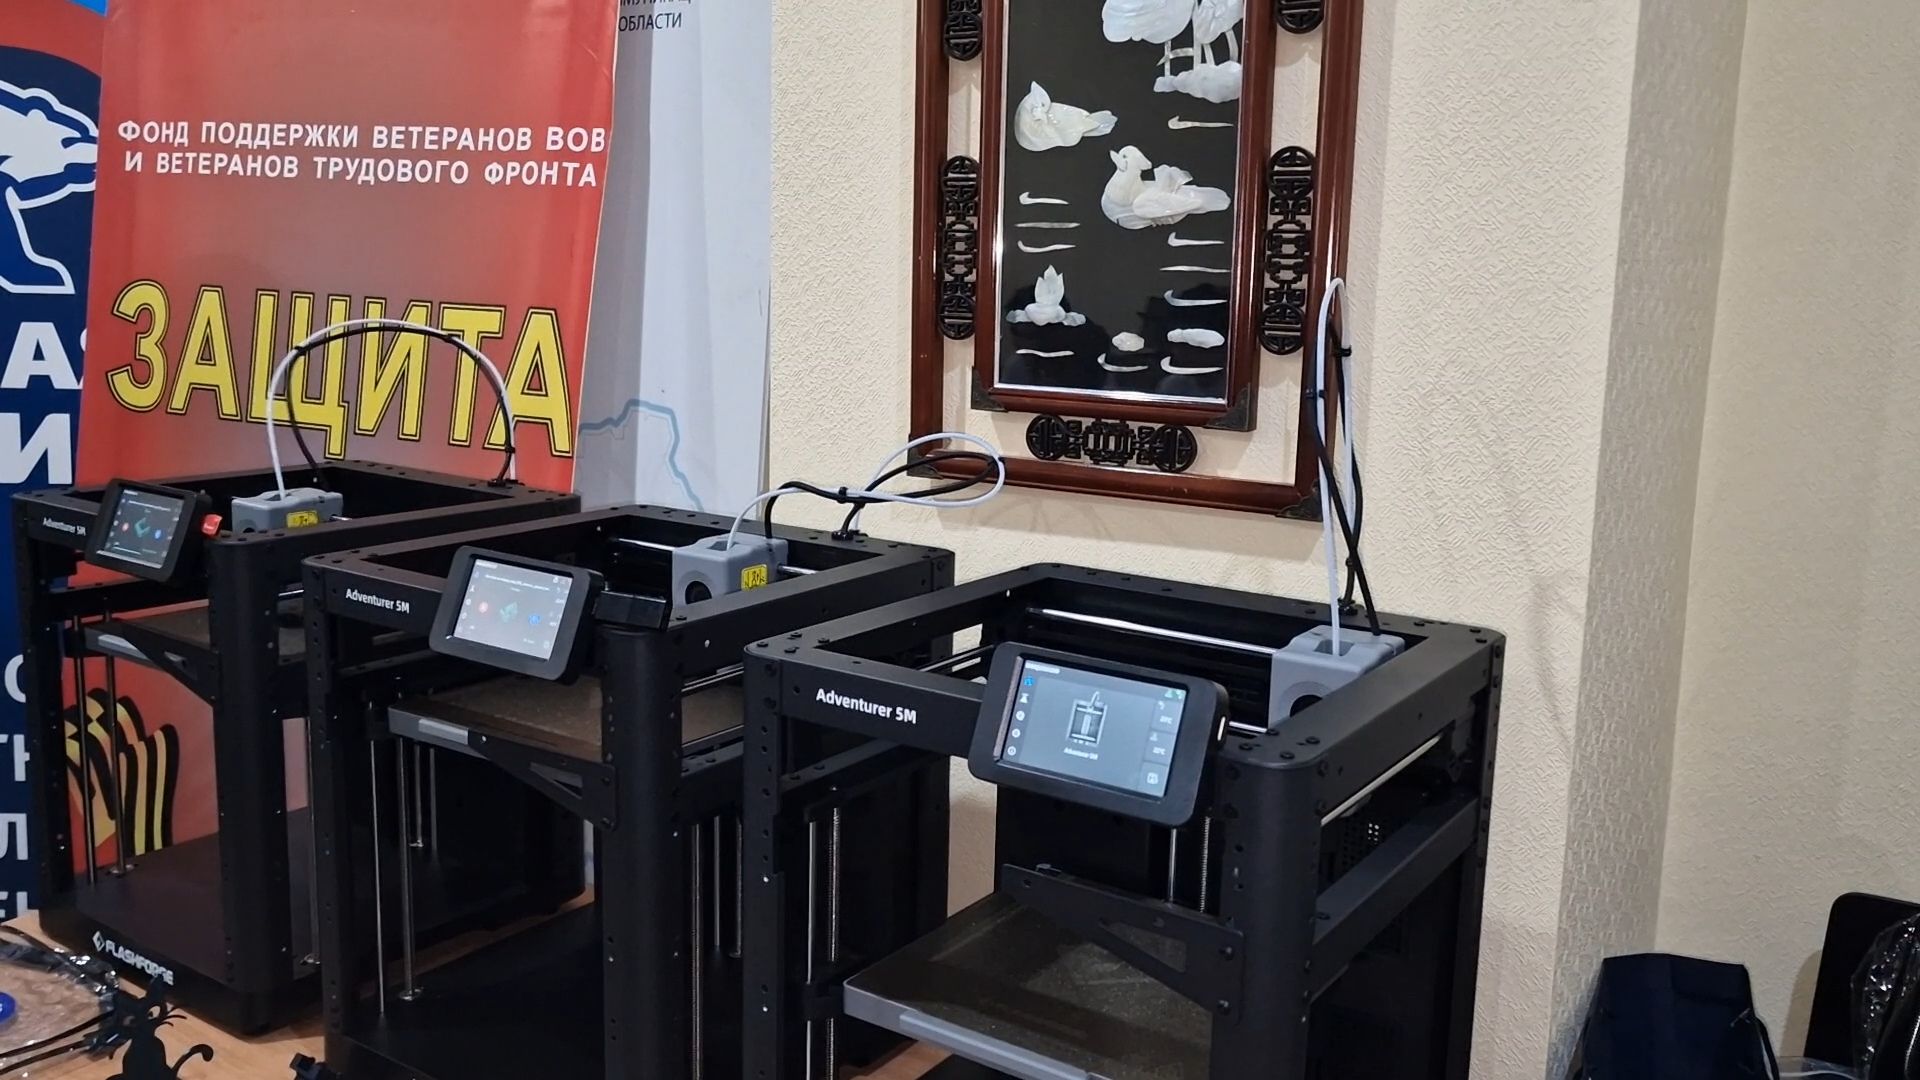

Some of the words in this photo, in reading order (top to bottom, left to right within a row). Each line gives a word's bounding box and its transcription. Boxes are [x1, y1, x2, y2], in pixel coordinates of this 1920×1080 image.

[618, 13, 682, 31] ОБЛАСТИ
[118, 120, 189, 147] ФОНД
[200, 121, 358, 149] ПОДДЕРЖКИ
[372, 125, 532, 152] ВЕТЕРАНОВ
[546, 126, 605, 153] ВОВ
[124, 150, 143, 173] И
[156, 152, 299, 178] ВЕТЕРАНОВ
[313, 156, 469, 185] ТРУДОВОГО
[484, 161, 597, 187] ФРОНТА
[106, 279, 574, 460] ЗАЩИТА
[345, 588, 395, 610] Adventurer
[396, 600, 410, 614] 5M
[815, 687, 893, 719] Adventurer
[895, 706, 917, 725] 5M
